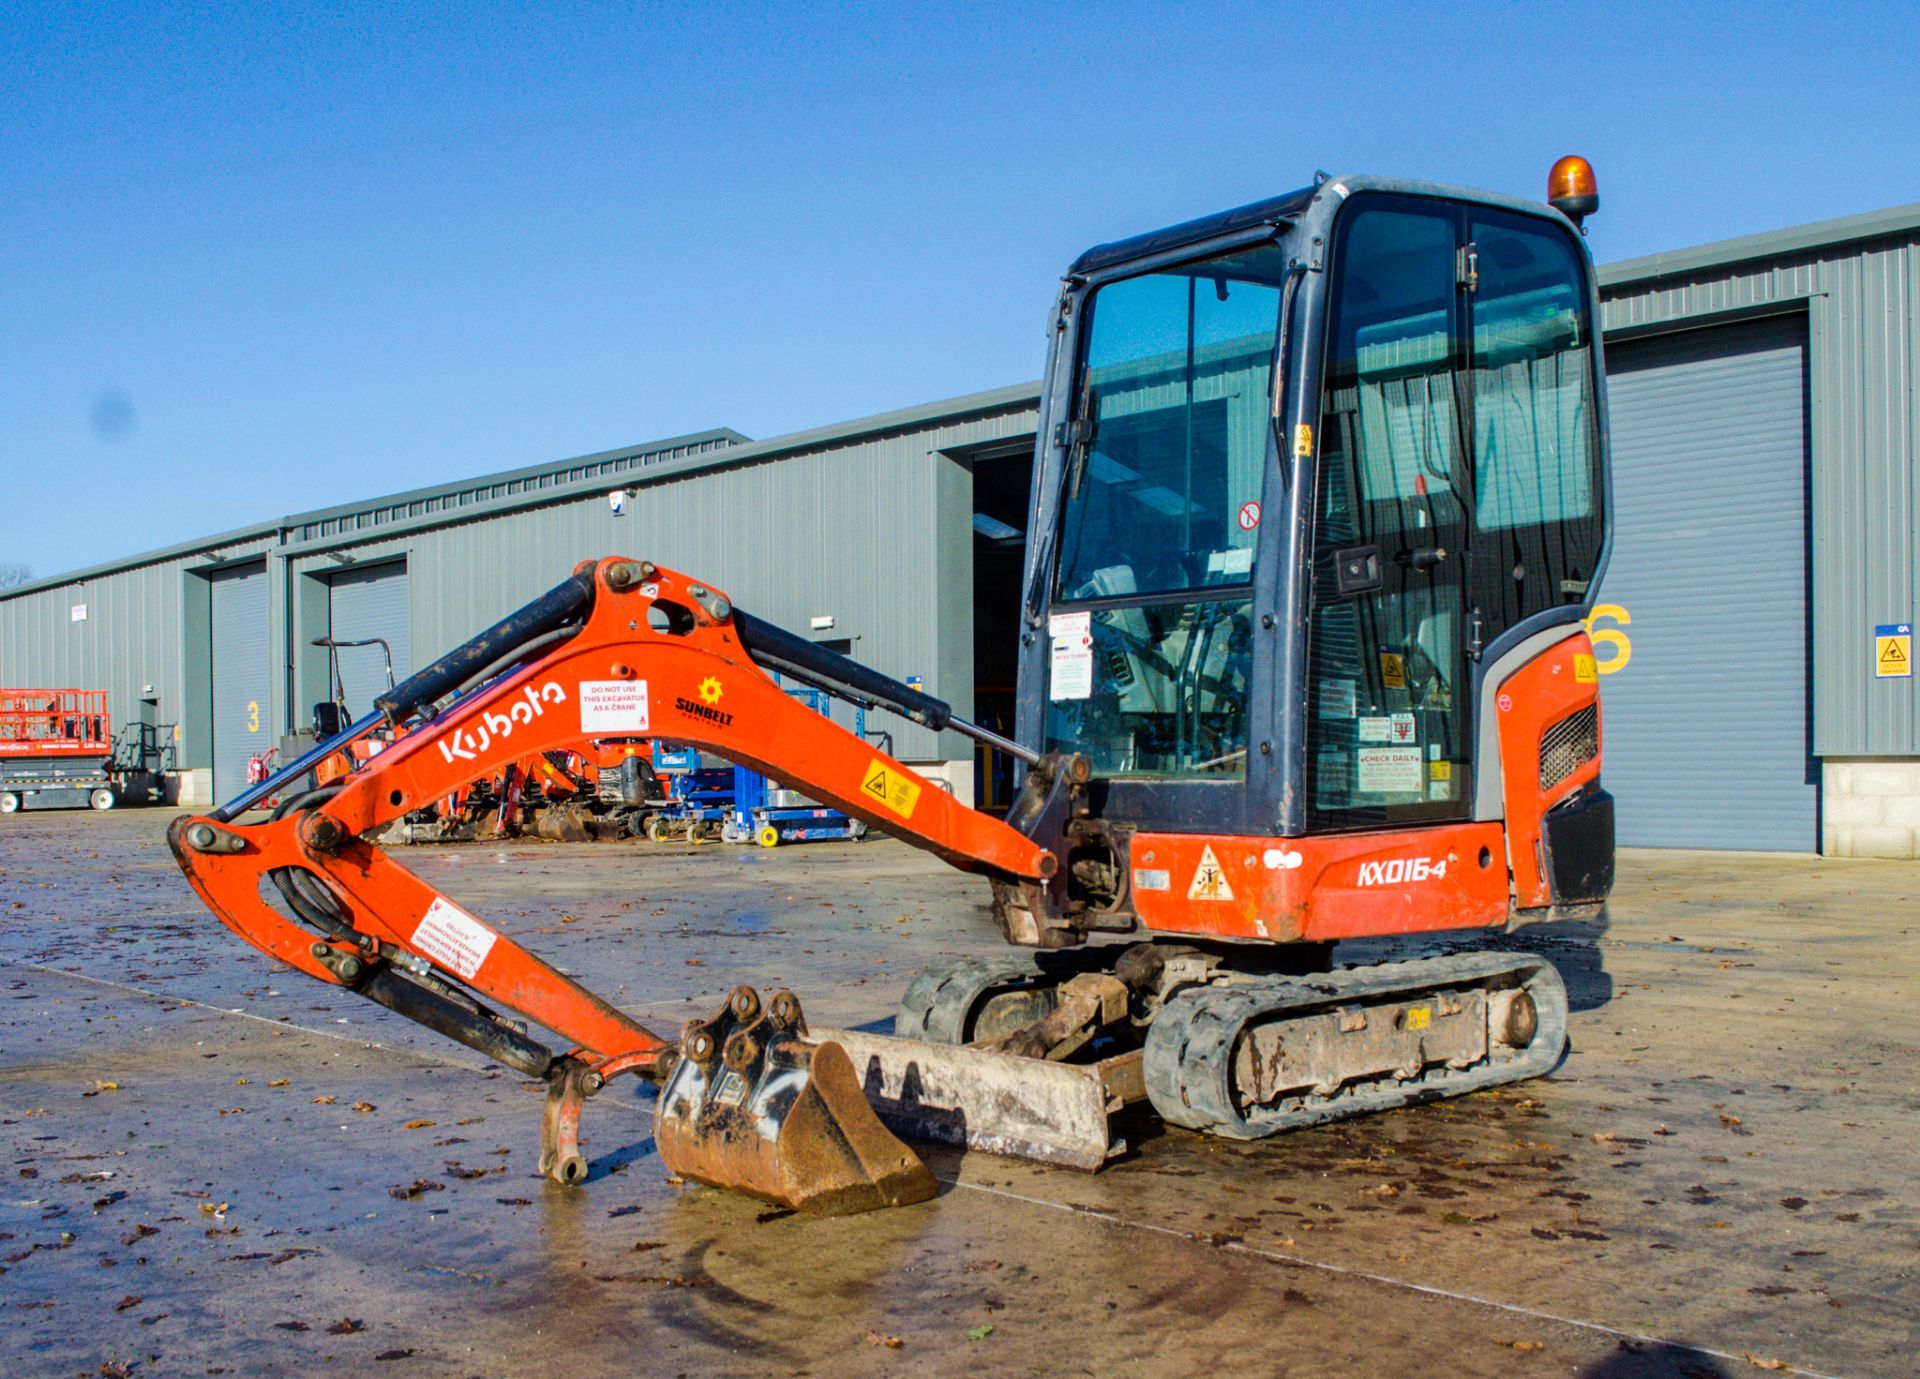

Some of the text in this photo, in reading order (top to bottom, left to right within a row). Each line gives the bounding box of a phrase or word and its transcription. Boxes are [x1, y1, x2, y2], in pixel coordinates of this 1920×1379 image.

[1581, 604, 1632, 675] 6
[591, 686, 604, 694] DO
[602, 694, 645, 702] EXCAVATOR
[248, 700, 259, 733] 3
[437, 681, 567, 764] Kubota
[675, 697, 734, 726] SUNBELT
[1364, 753, 1415, 762] CHECK DAILY
[1357, 857, 1447, 887] KX016-4
